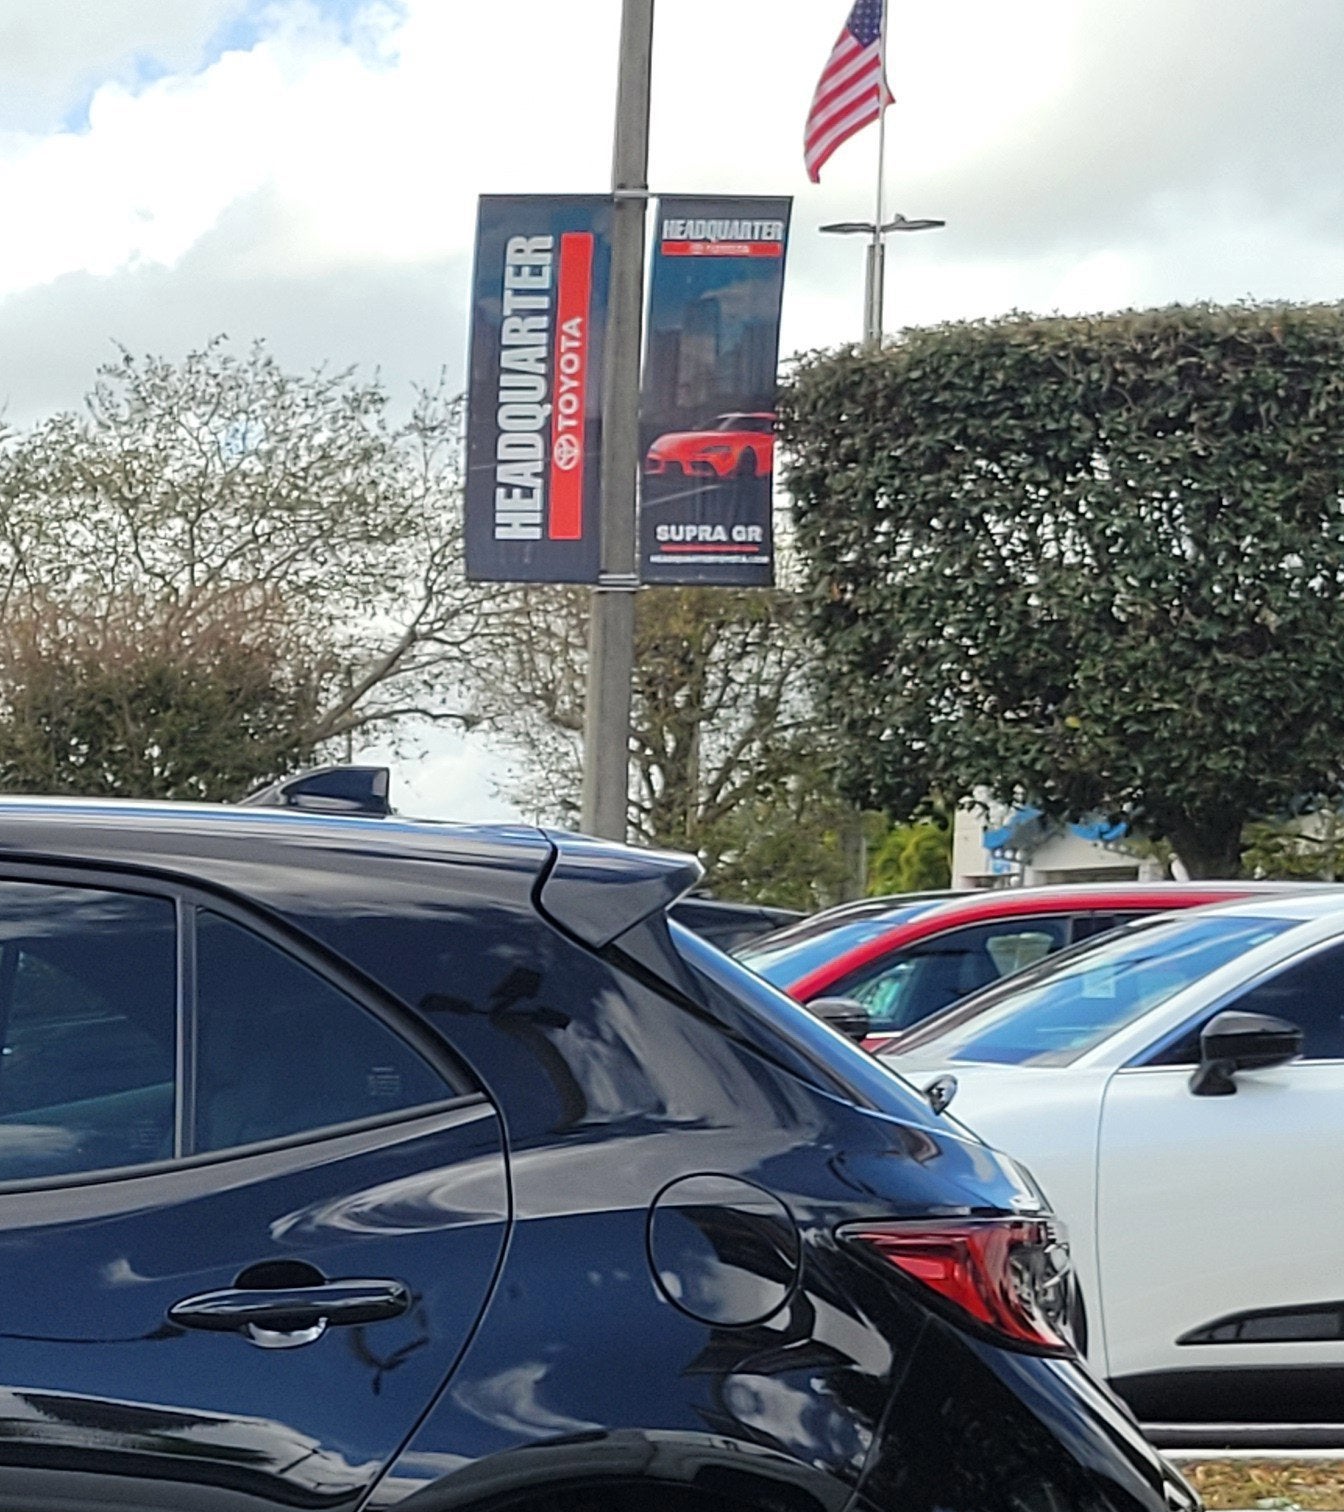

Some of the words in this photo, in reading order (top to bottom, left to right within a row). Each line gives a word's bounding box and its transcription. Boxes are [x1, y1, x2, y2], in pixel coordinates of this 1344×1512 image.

[662, 218, 785, 242] HEADQUARTER
[494, 234, 555, 541] HEADQUARTER
[557, 316, 583, 432] TOYOTA
[655, 524, 728, 542] SUPRA
[731, 524, 763, 542] GR
